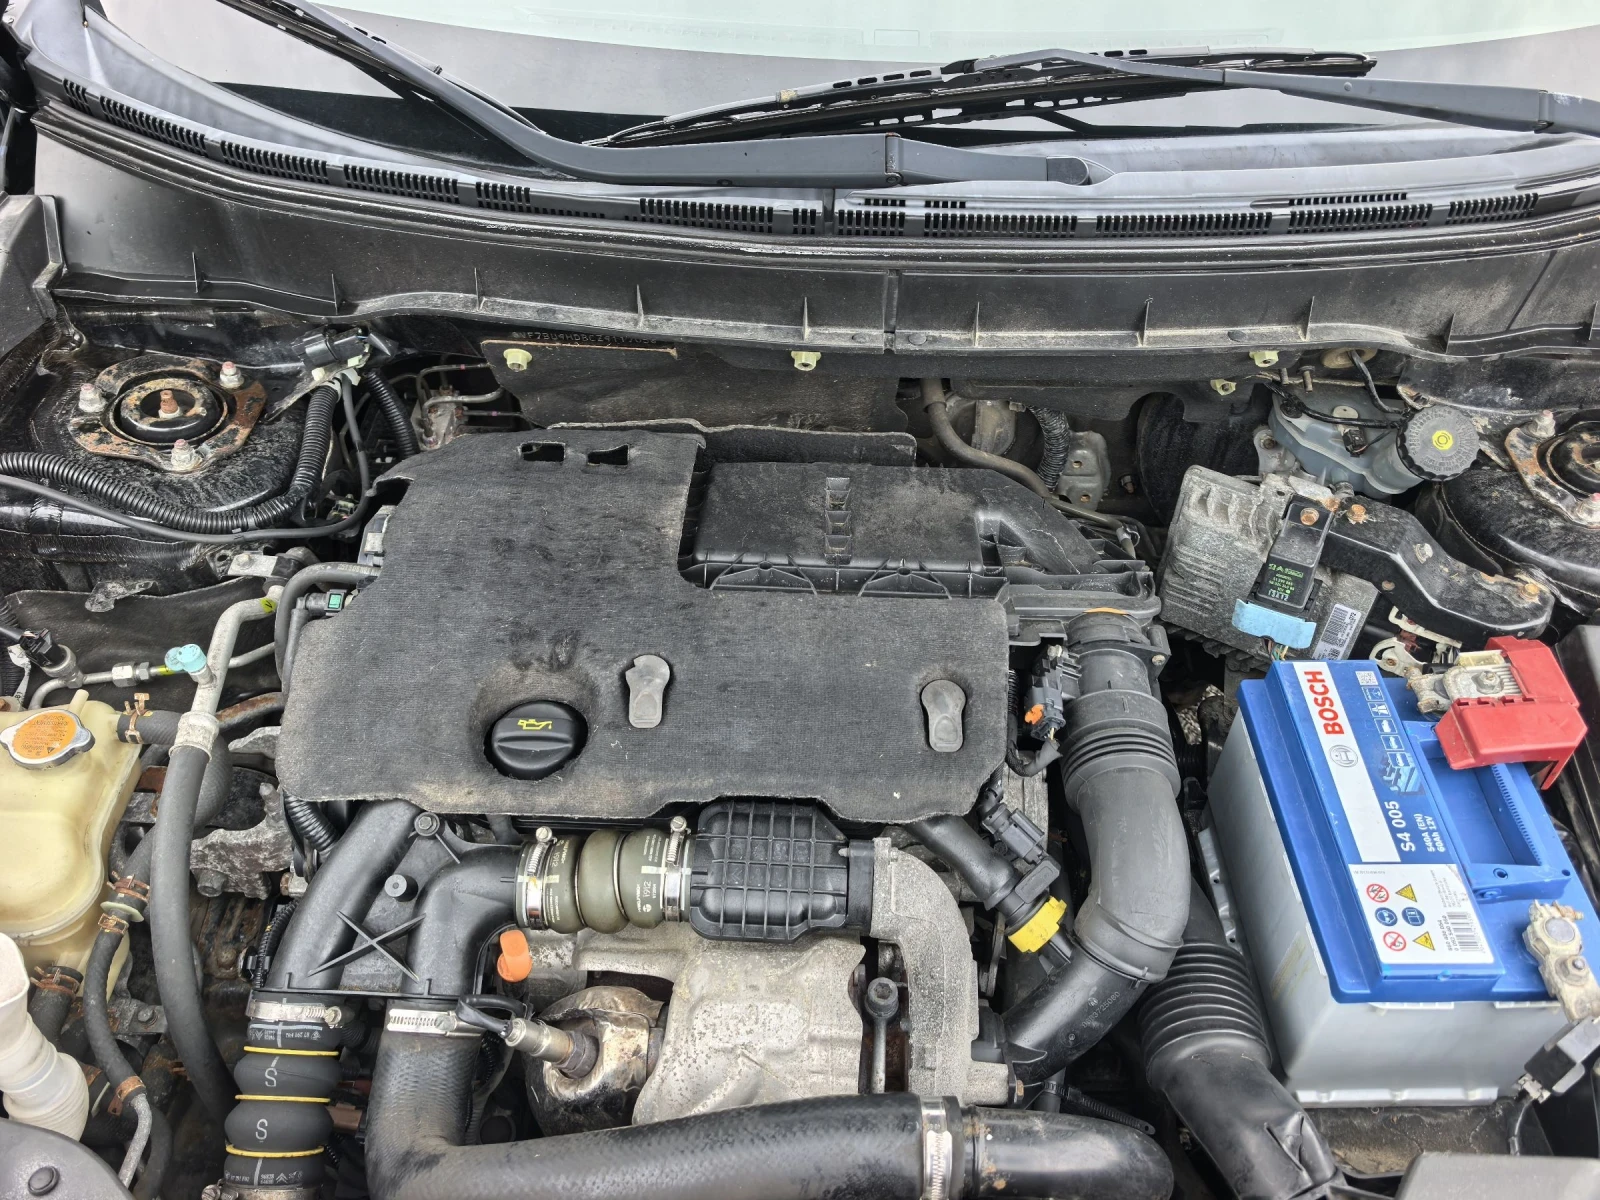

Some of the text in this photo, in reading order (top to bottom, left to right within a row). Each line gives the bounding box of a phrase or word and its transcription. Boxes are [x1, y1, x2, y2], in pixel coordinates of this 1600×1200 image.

[1304, 671, 1344, 735] BOSCH
[1384, 801, 1416, 852] S4 005
[1413, 814, 1435, 852] 540A (EN)
[1424, 816, 1445, 852] 60Ah 12V
[256, 1119, 268, 1140] S
